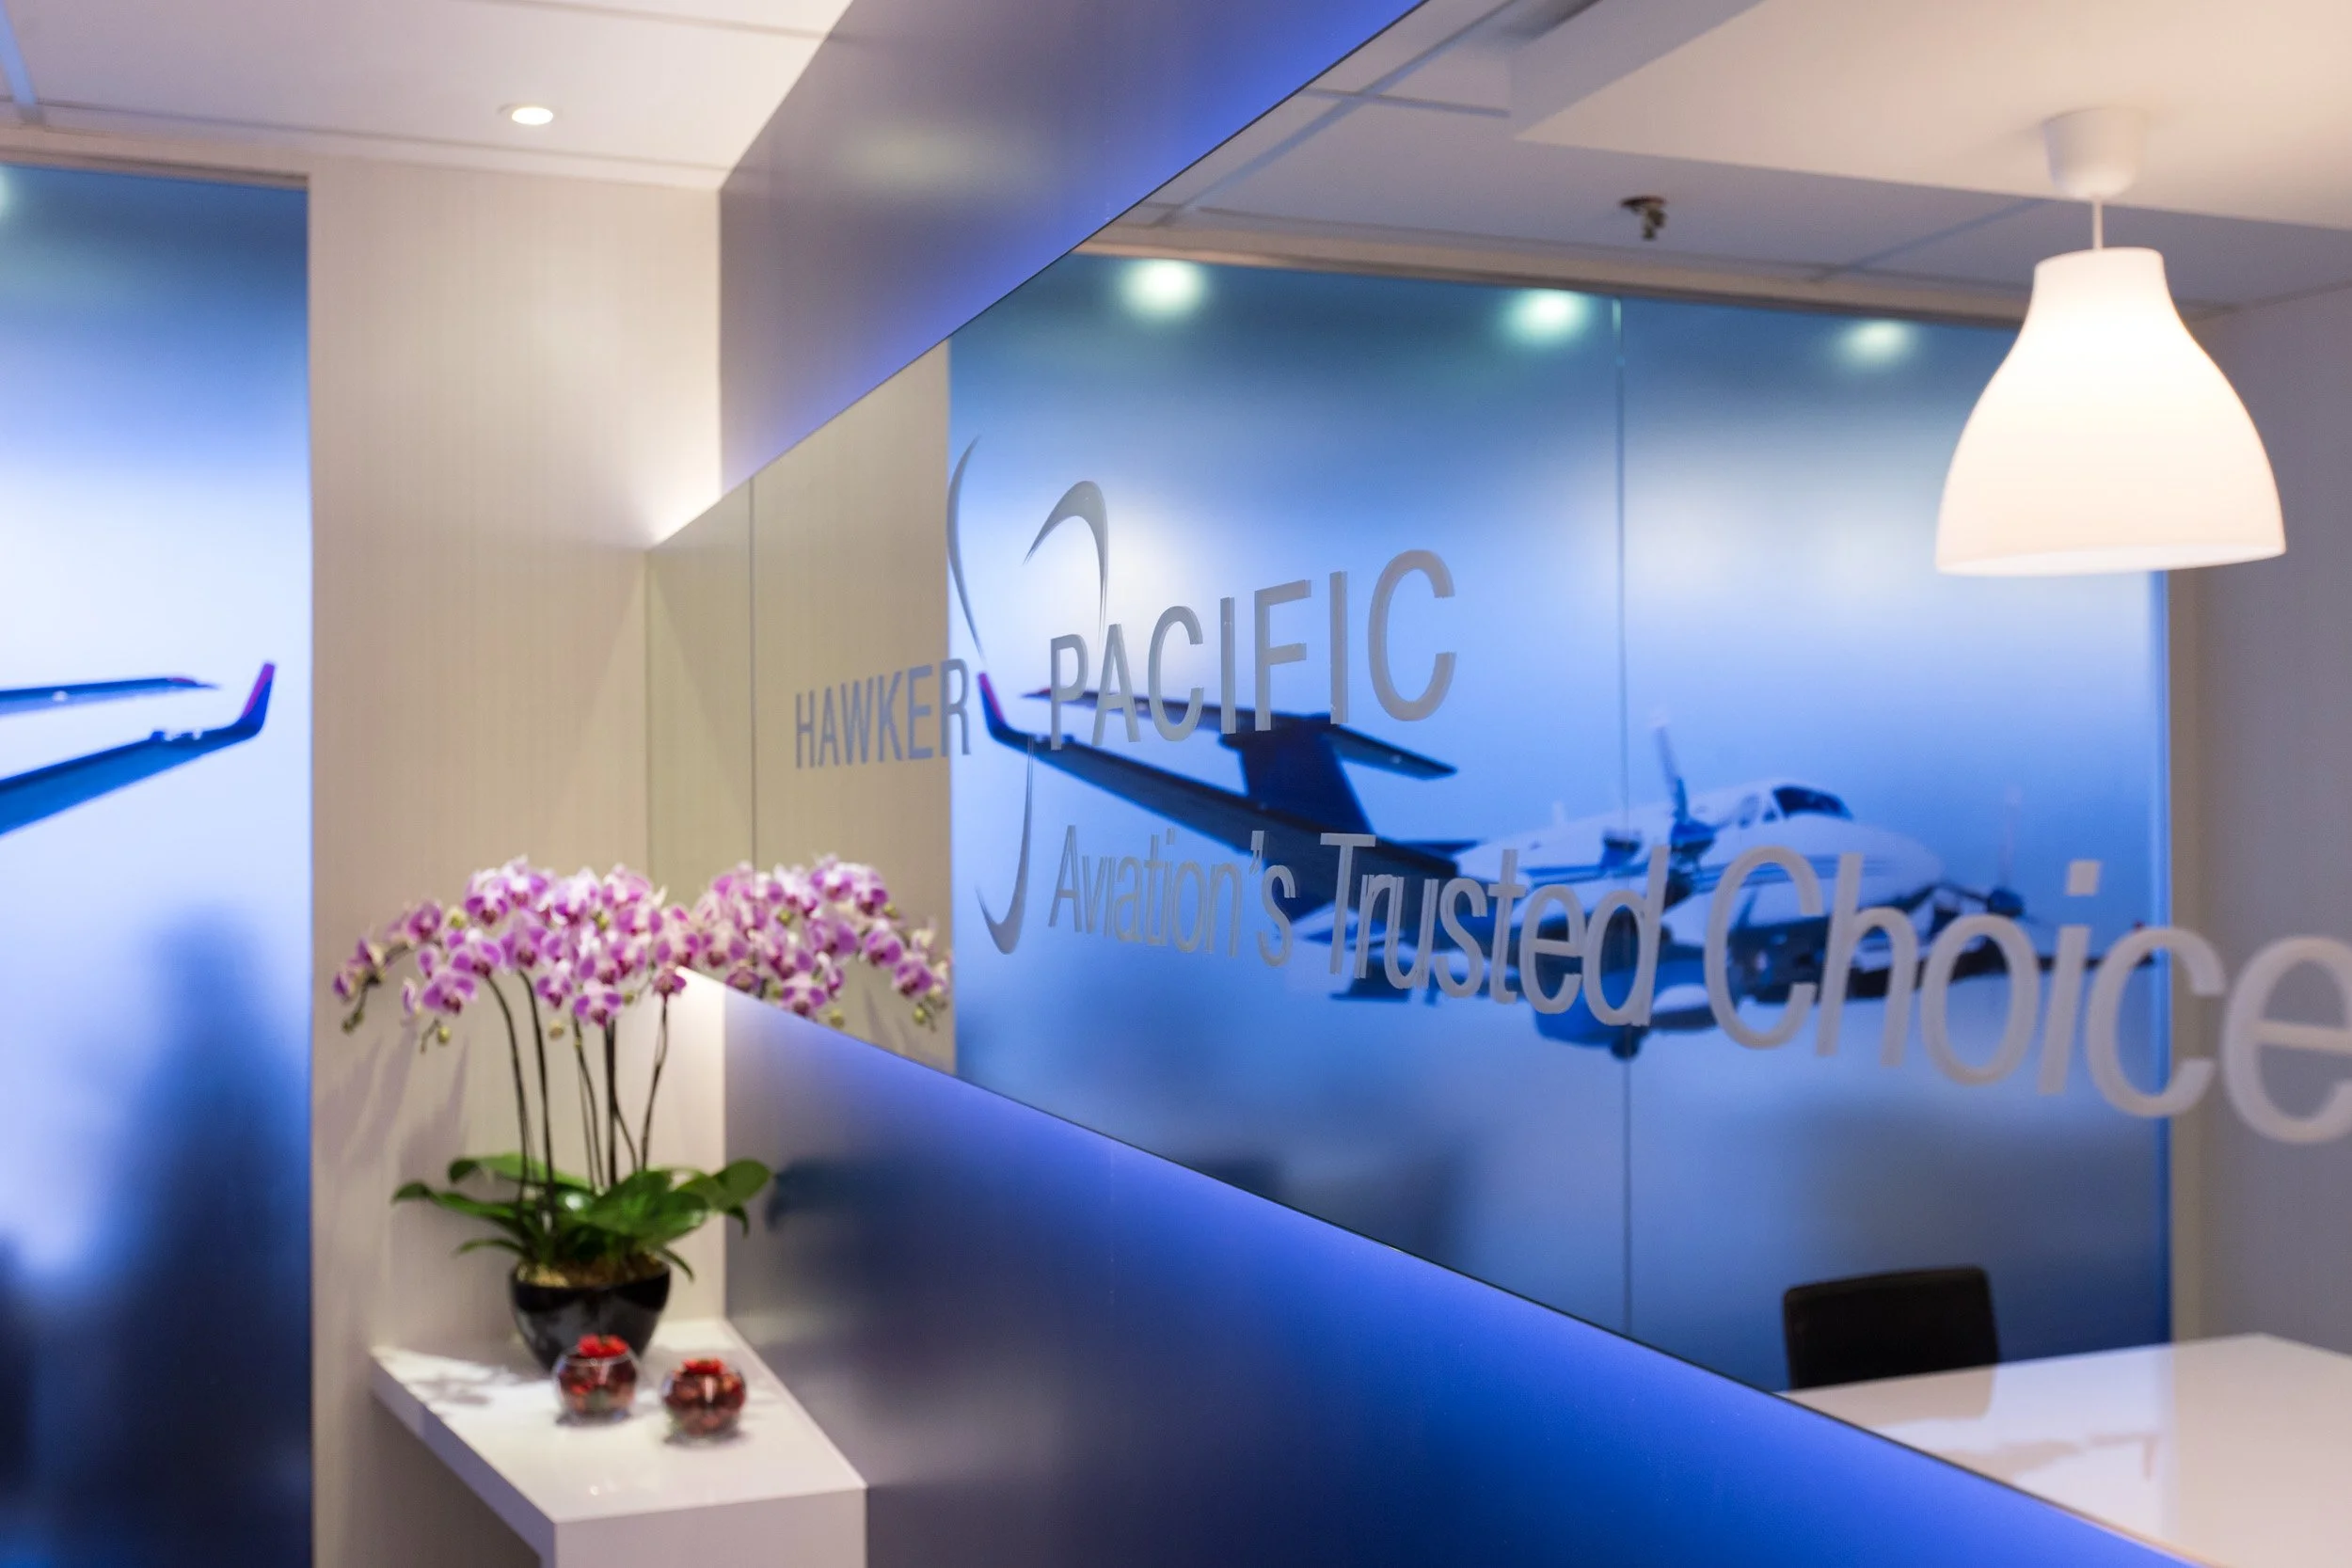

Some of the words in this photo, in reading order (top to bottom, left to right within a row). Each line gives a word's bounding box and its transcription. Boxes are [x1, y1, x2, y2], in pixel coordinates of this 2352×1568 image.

[795, 657, 971, 769] HAWKER
[1051, 548, 1457, 752] PACIFIC
[1320, 832, 1669, 1027] Trusted
[1704, 846, 2352, 1144] Choice
